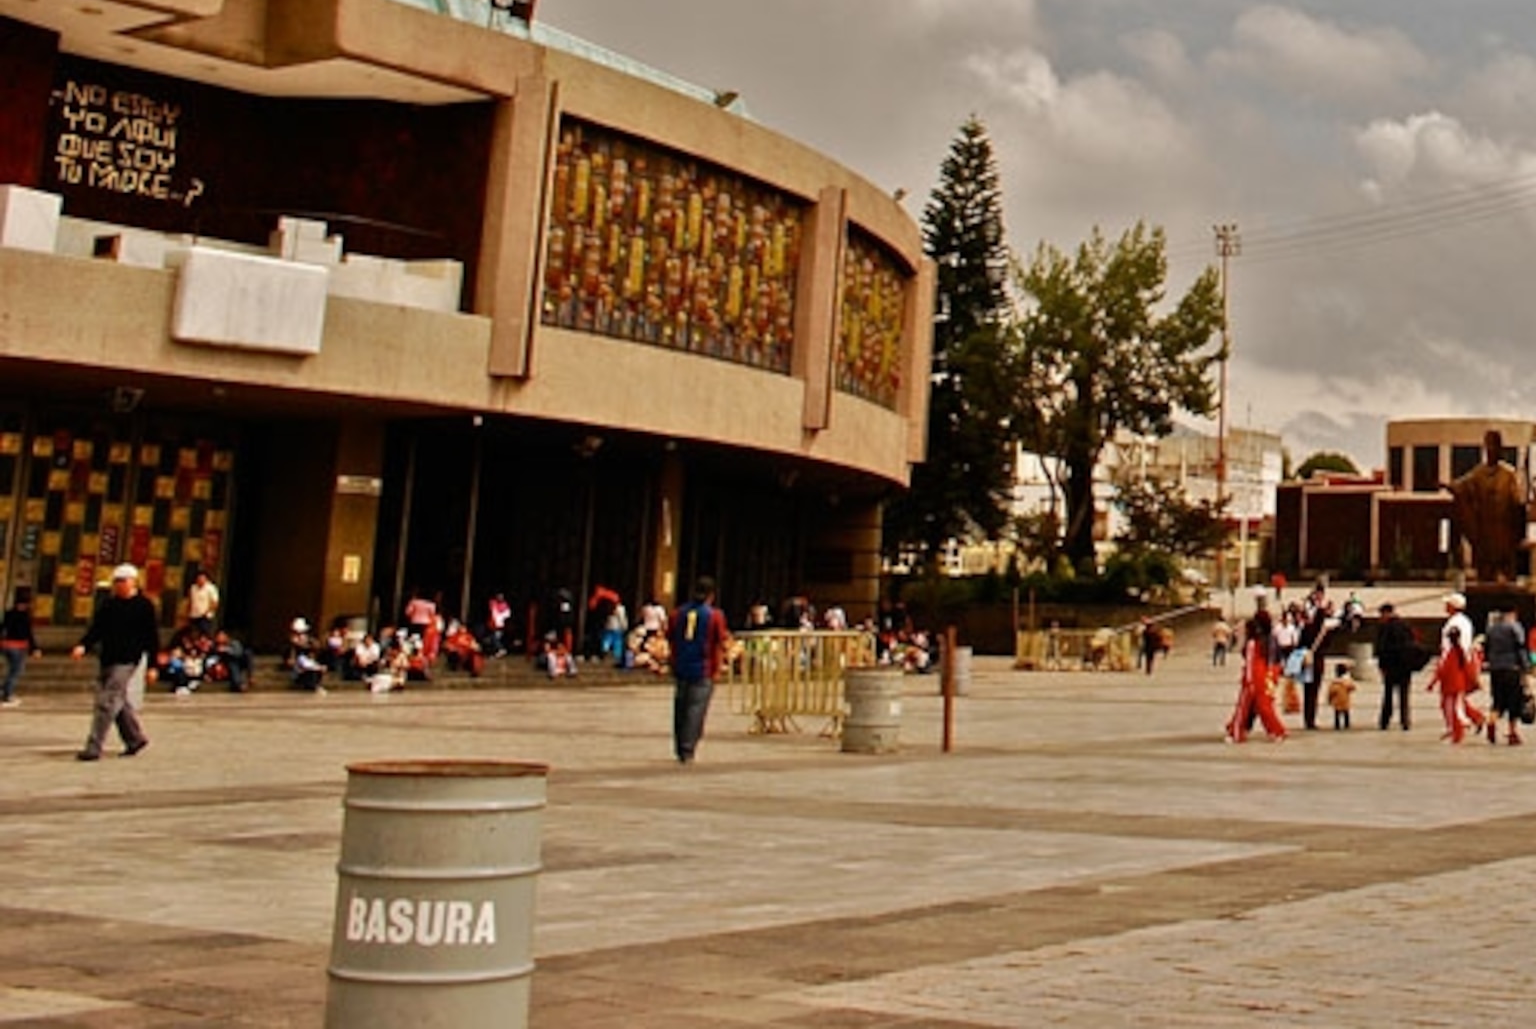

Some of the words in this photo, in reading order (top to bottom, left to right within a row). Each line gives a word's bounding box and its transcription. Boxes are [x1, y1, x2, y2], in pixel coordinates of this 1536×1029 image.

[63, 105, 107, 133] YO
[109, 117, 176, 150] AQUI
[54, 155, 83, 184] TU
[57, 133, 113, 162] QUE
[117, 141, 176, 172] SOY
[347, 896, 495, 945] BASURA
